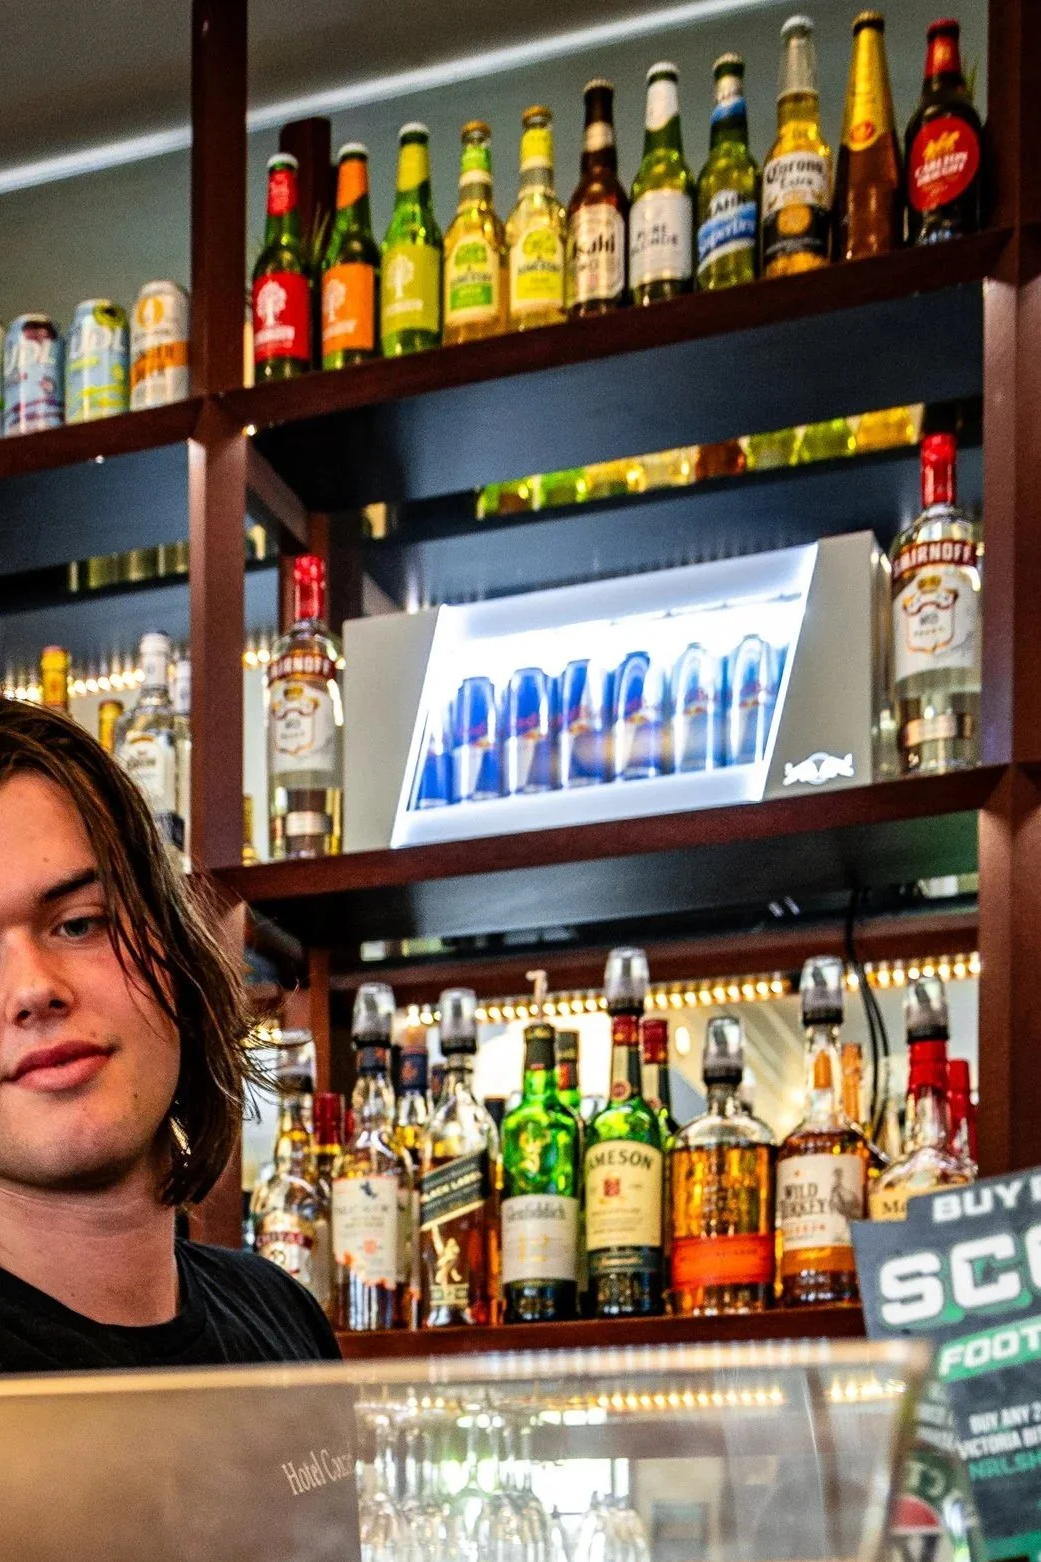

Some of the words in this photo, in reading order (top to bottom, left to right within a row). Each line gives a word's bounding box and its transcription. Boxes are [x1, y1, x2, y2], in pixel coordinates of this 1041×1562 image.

[784, 1182, 818, 1200] WILD
[932, 1177, 1024, 1224] BUY
[969, 1410, 999, 1436] BUY
[1000, 1403, 1030, 1428] ANY
[281, 1449, 327, 1496] Hotel
